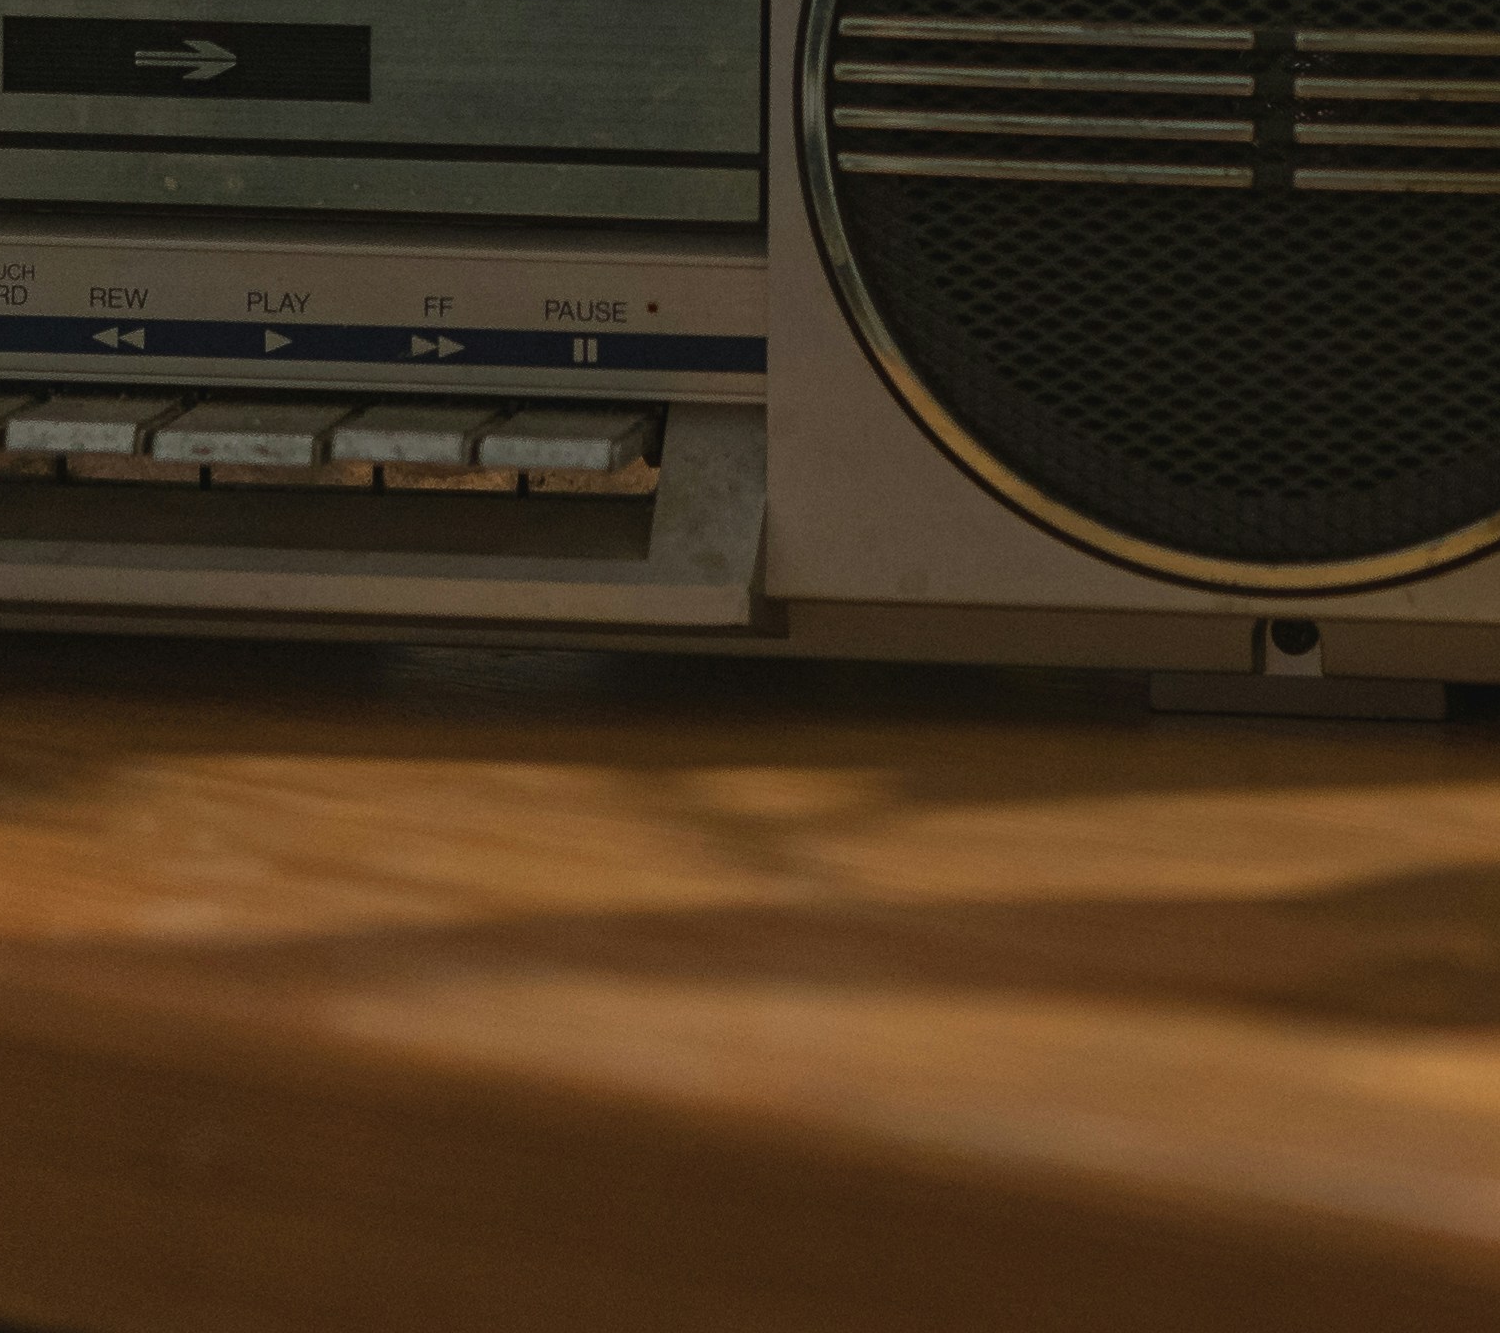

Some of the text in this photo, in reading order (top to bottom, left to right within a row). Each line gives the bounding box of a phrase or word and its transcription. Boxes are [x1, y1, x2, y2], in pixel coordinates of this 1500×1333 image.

[90, 287, 148, 310] REW
[246, 291, 311, 314] PLAY
[424, 296, 454, 318] FF
[545, 299, 628, 323] PAUSE
